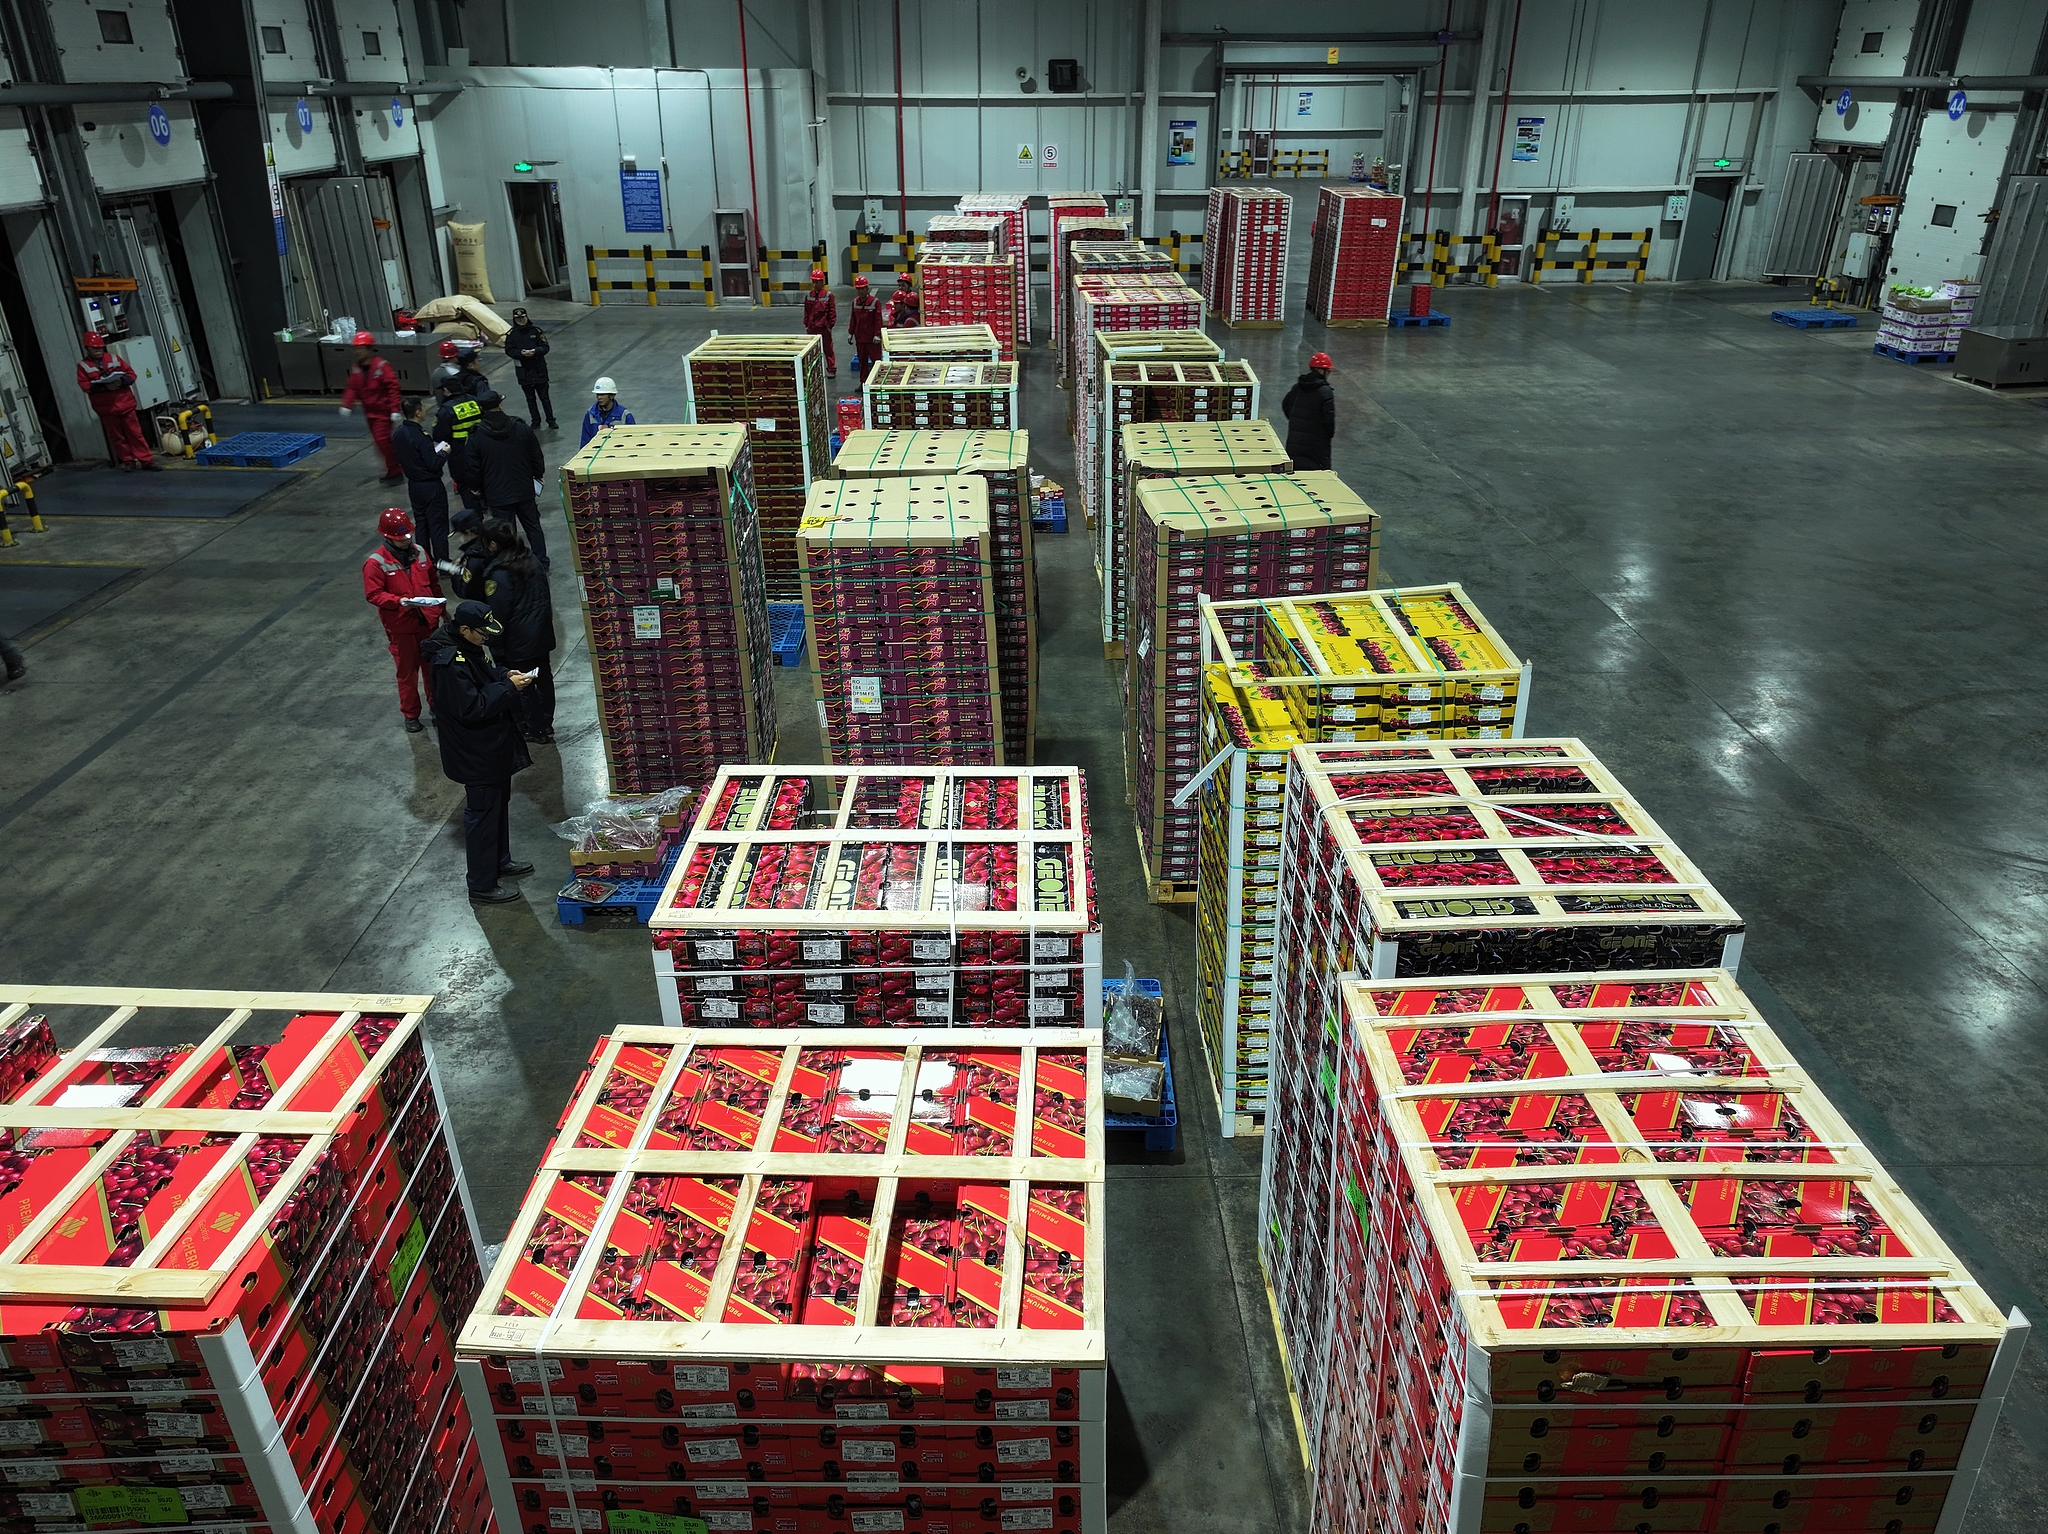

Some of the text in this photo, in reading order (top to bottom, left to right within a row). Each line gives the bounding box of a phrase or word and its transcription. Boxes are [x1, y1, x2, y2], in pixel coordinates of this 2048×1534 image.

[1838, 96, 1849, 110] 43
[1950, 98, 1965, 114] 44
[298, 108, 312, 127] 07
[392, 105, 403, 121] 08
[150, 115, 169, 136] 06
[1047, 149, 1053, 158] 5
[1374, 851, 1476, 866] GEONE
[1403, 899, 1516, 918] GEONE
[1420, 939, 1476, 955] GEONE
[1599, 934, 1657, 949] GEONE
[1465, 1185, 1477, 1207] HERRIES
[561, 1204, 587, 1220] PREMIUM
[1030, 1207, 1060, 1225] PREMIUM
[1025, 1297, 1058, 1317] PREMIUM
